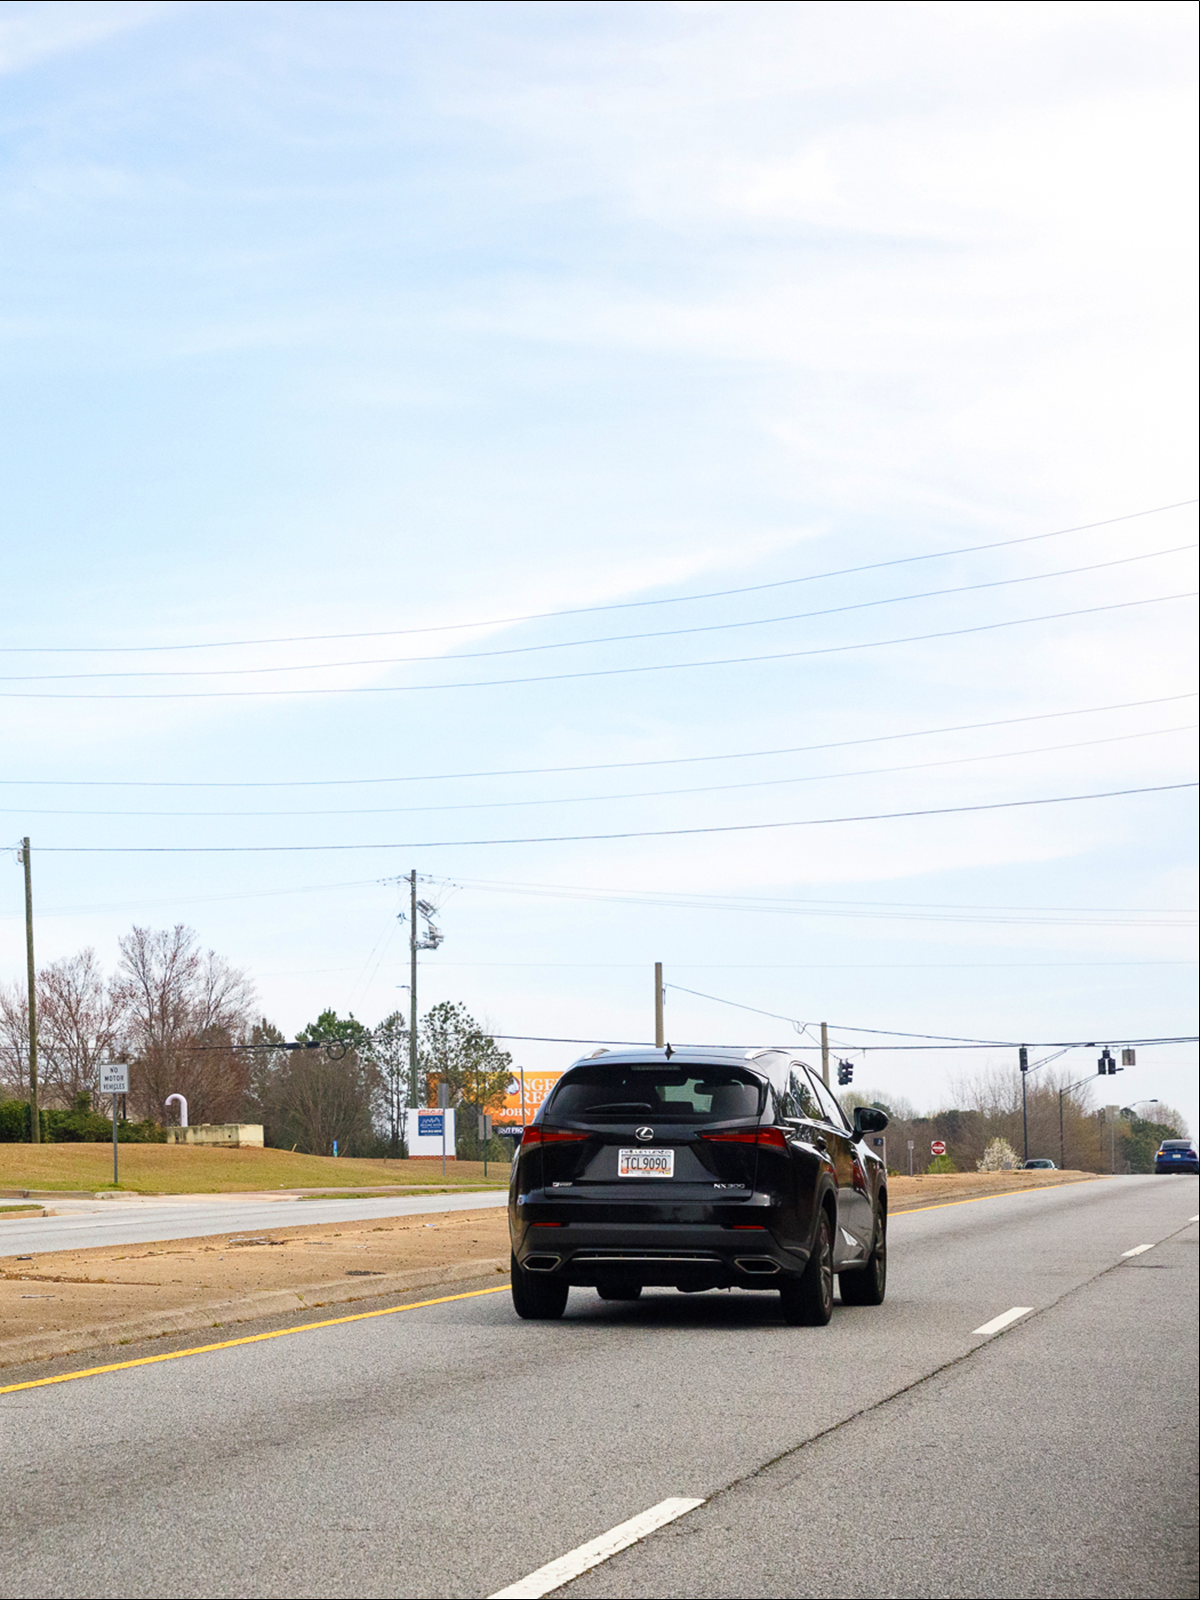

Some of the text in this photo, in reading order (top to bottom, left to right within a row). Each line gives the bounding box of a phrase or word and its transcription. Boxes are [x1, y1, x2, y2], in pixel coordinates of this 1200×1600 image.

[519, 1079, 559, 1091] NGE
[500, 1108, 531, 1117] JOHN
[625, 1157, 667, 1170] TCL9090
